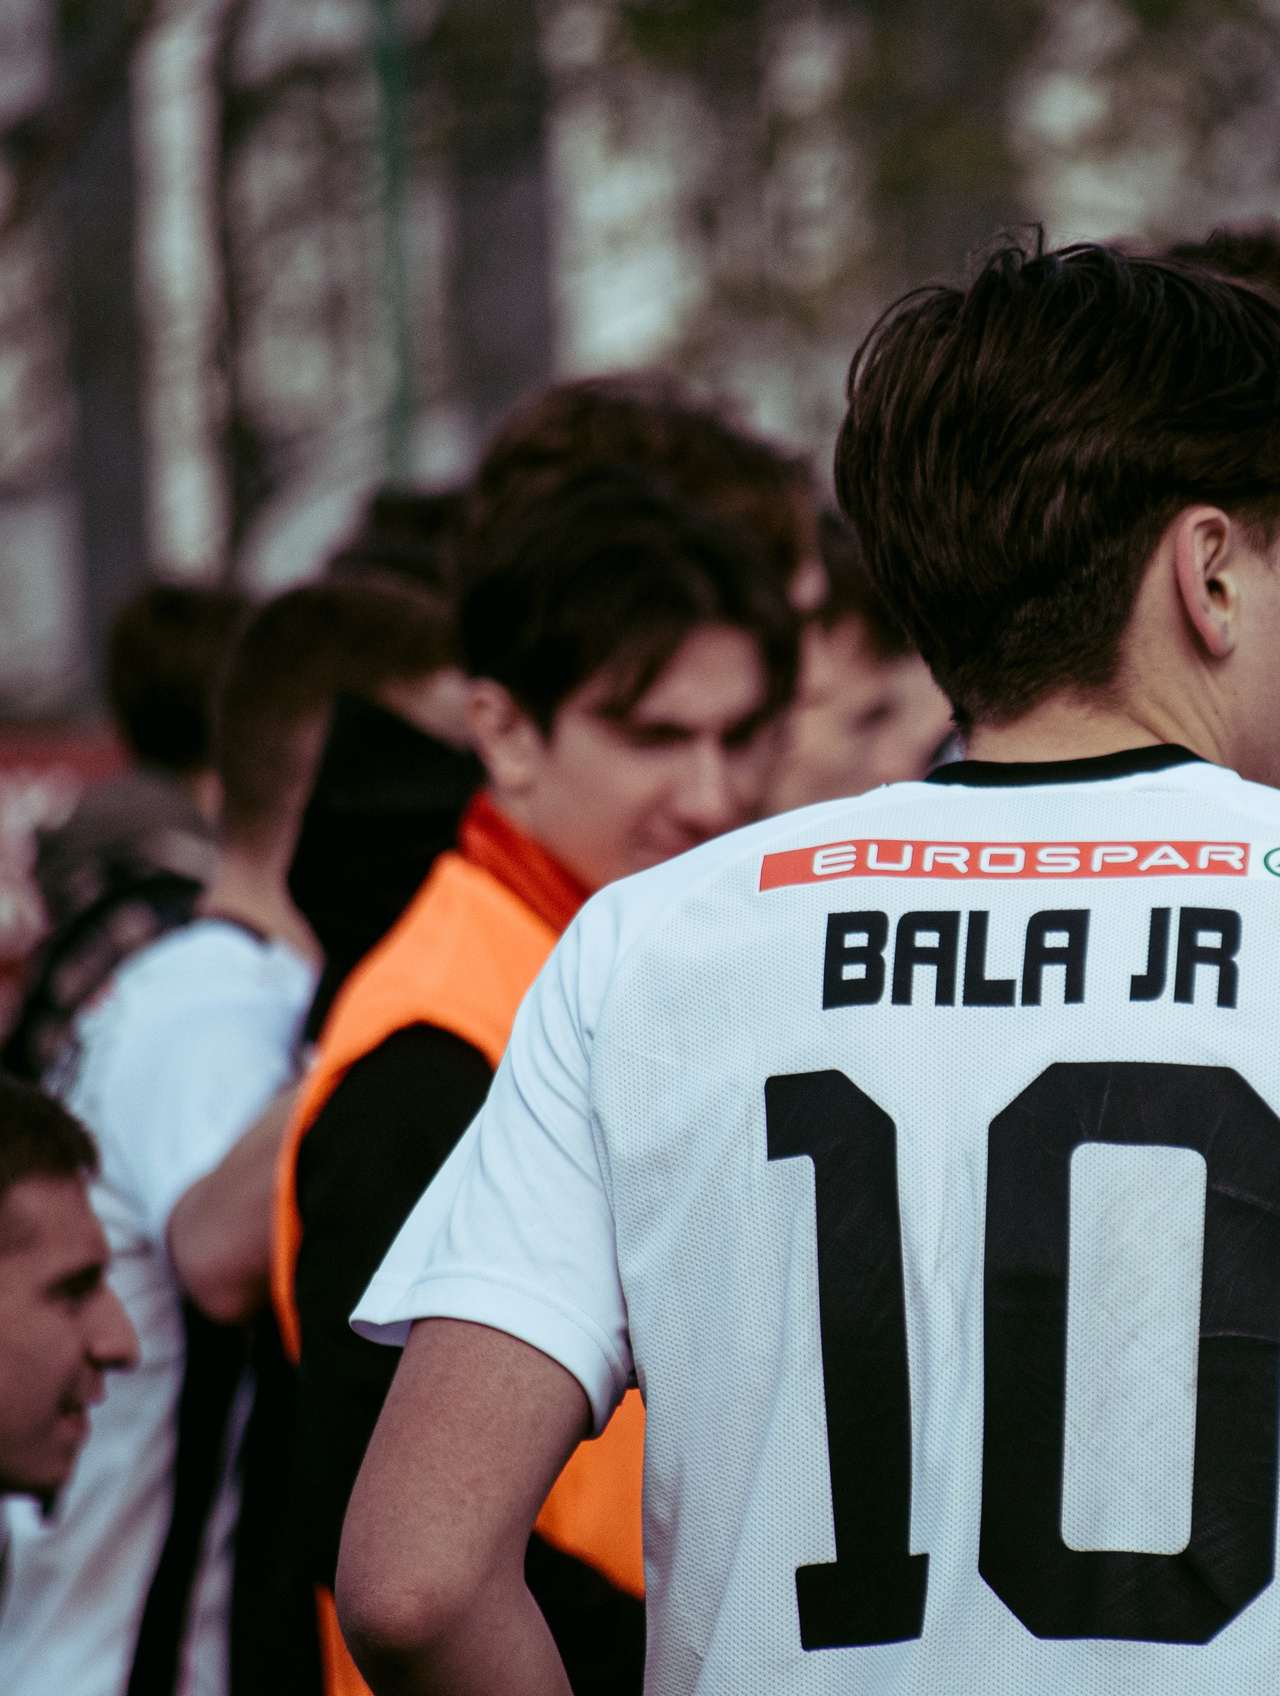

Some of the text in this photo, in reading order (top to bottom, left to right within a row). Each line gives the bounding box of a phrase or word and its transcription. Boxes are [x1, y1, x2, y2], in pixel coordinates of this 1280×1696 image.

[813, 844, 1244, 875] EUROSPAR
[822, 907, 1242, 1009] BALA JR
